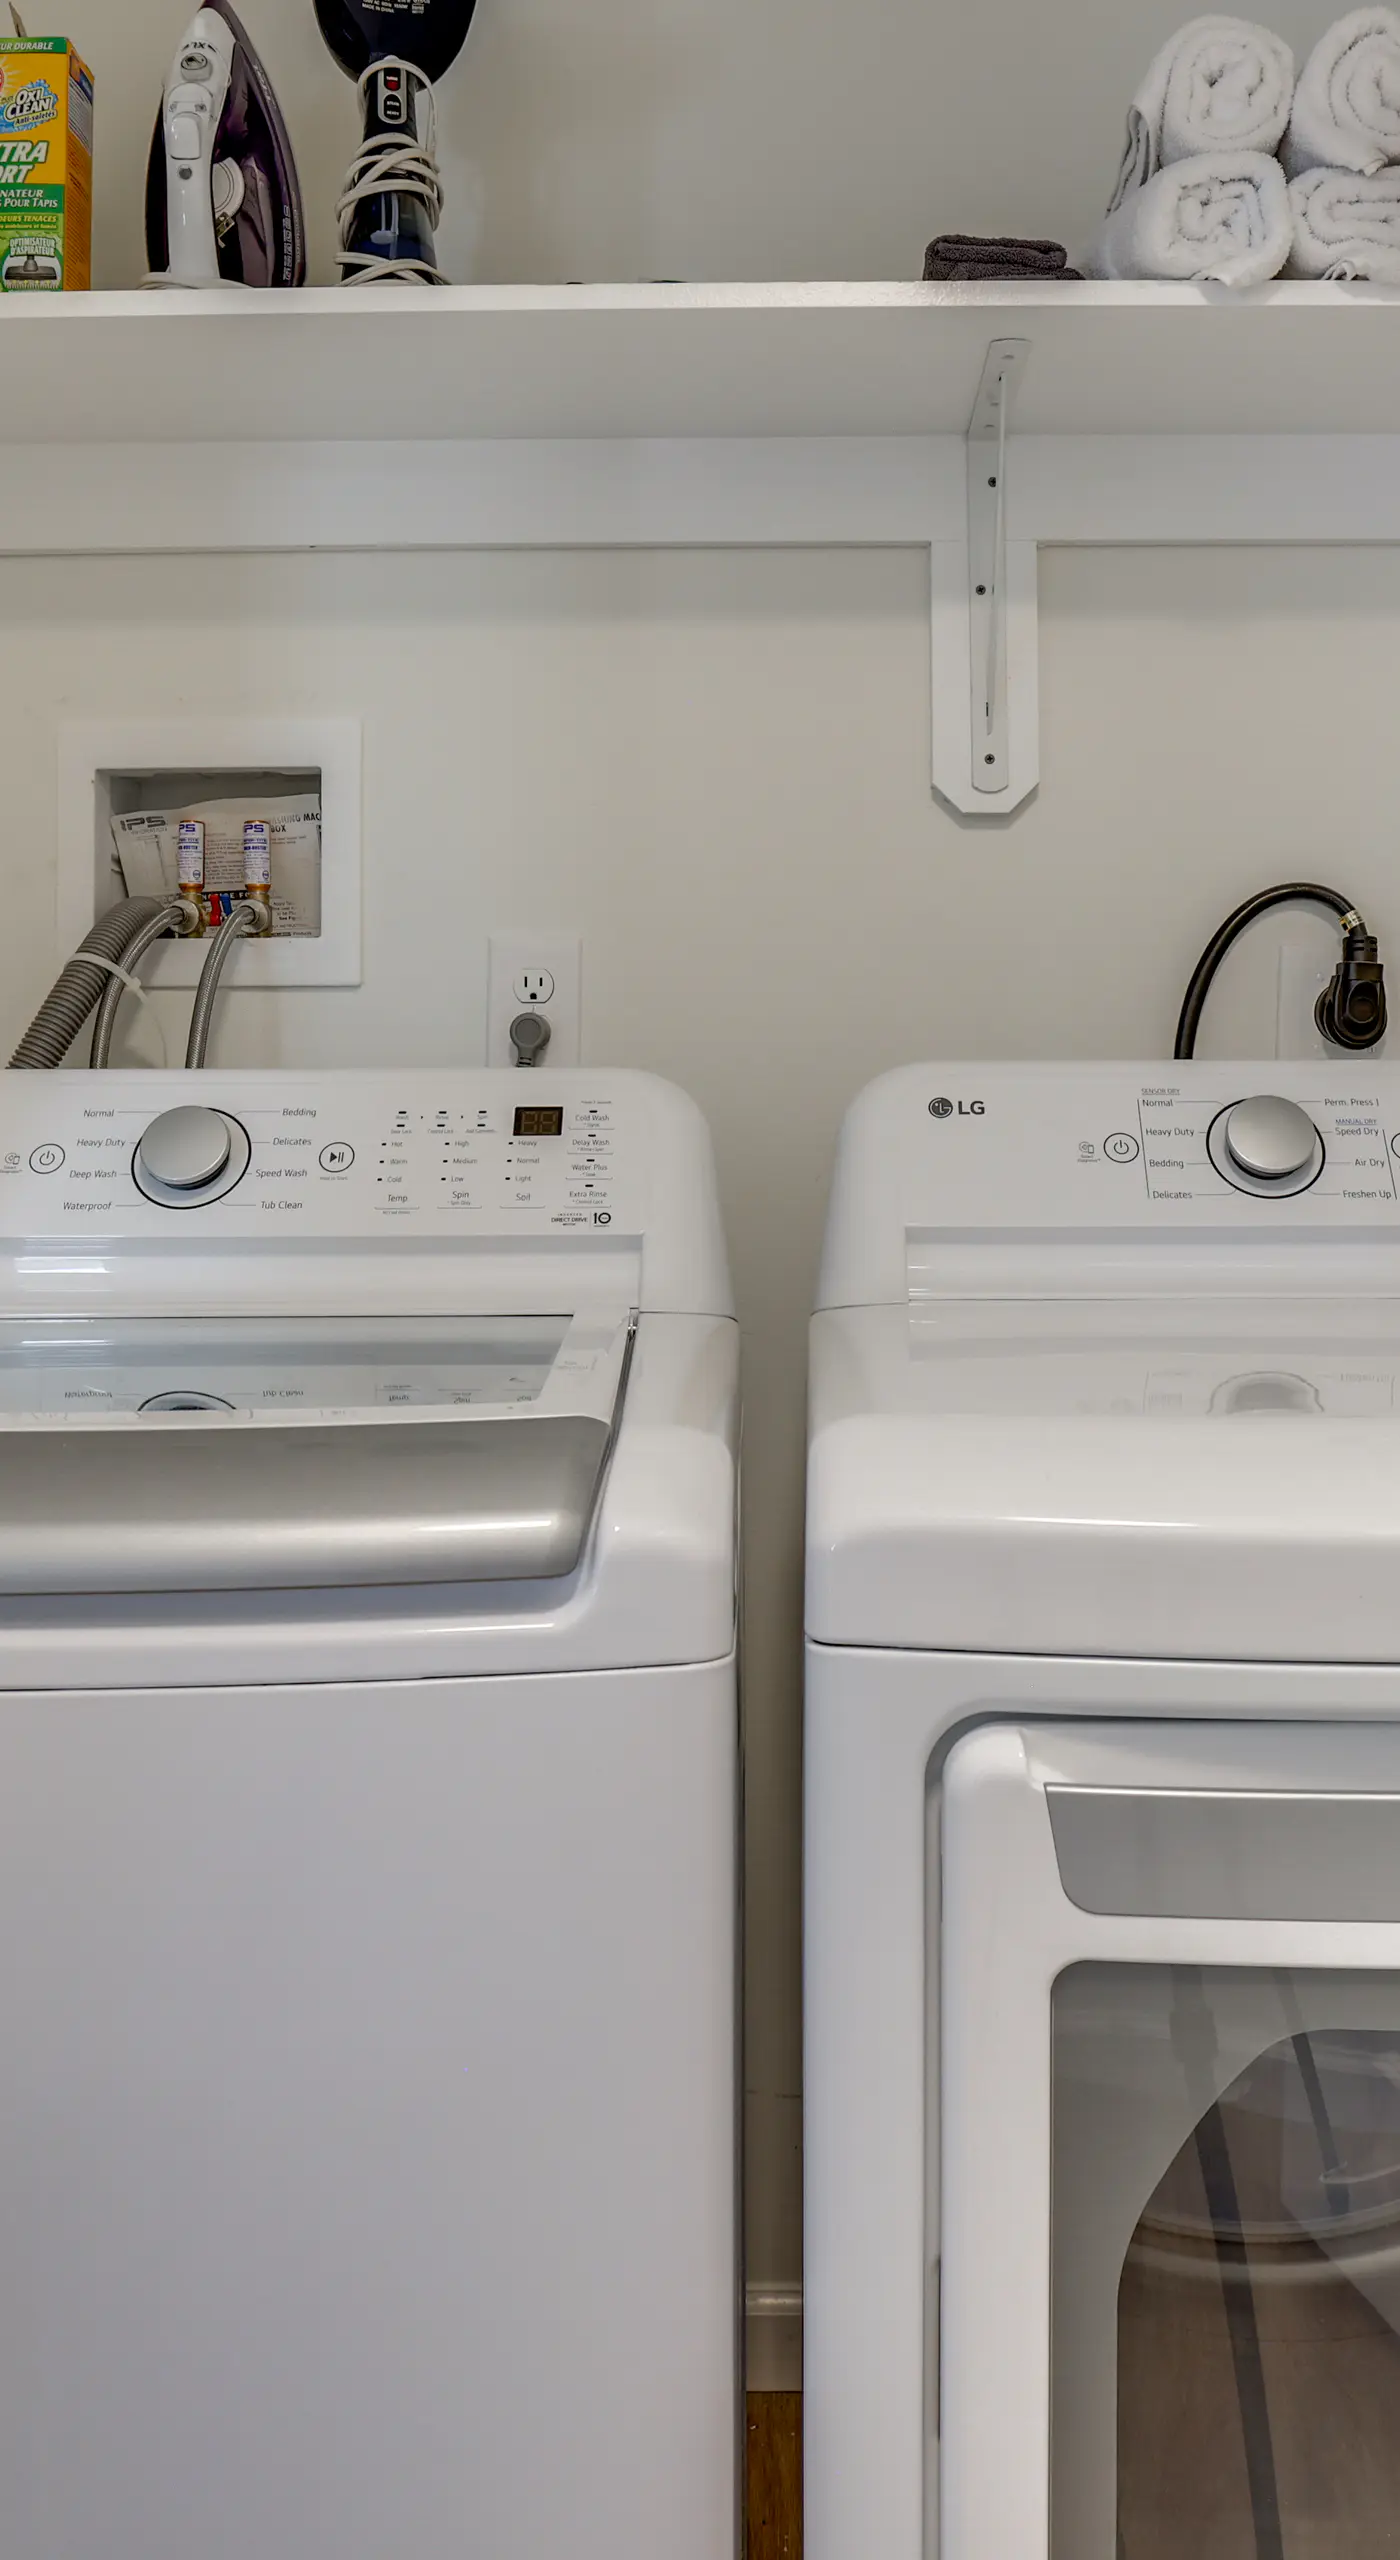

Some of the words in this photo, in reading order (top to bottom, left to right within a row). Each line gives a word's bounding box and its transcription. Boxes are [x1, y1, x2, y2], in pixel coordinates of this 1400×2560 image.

[14, 41, 53, 50] DURABLE
[16, 89, 42, 104] OXI
[6, 97, 51, 120] CLEAN
[120, 816, 166, 832] IPS
[1142, 1099, 1173, 1107] Normal
[1324, 1098, 1349, 1106] Perm.
[1351, 1098, 1374, 1106] Press
[958, 1100, 985, 1115] LG
[83, 1109, 115, 1118] Normal
[282, 1108, 317, 1118] Bedding
[1145, 1128, 1171, 1137] Heavy
[1174, 1128, 1195, 1137] Duty
[1335, 1127, 1361, 1136] Speed
[1364, 1127, 1379, 1136] Dry
[76, 1138, 102, 1148] Heavy
[105, 1138, 126, 1147] Duty
[272, 1137, 312, 1146] Delicates
[455, 1140, 470, 1148] High
[572, 1139, 590, 1147] Delay
[1149, 1159, 1184, 1169] Bedding
[1369, 1159, 1385, 1168] Dry
[69, 1170, 91, 1180] Deep
[94, 1170, 117, 1178] Wash
[255, 1169, 282, 1179] Speed
[284, 1169, 308, 1177] Wash
[515, 1176, 531, 1184] Light
[388, 1194, 408, 1203] Temp
[452, 1190, 470, 1199] Spin
[515, 1193, 531, 1201] Soil
[1152, 1191, 1193, 1199] Delicates
[1343, 1190, 1377, 1198] Freshen
[1379, 1190, 1392, 1199] Up
[63, 1201, 113, 1212] Waterproof
[261, 1201, 276, 1209] Tub
[278, 1201, 303, 1209] Clean
